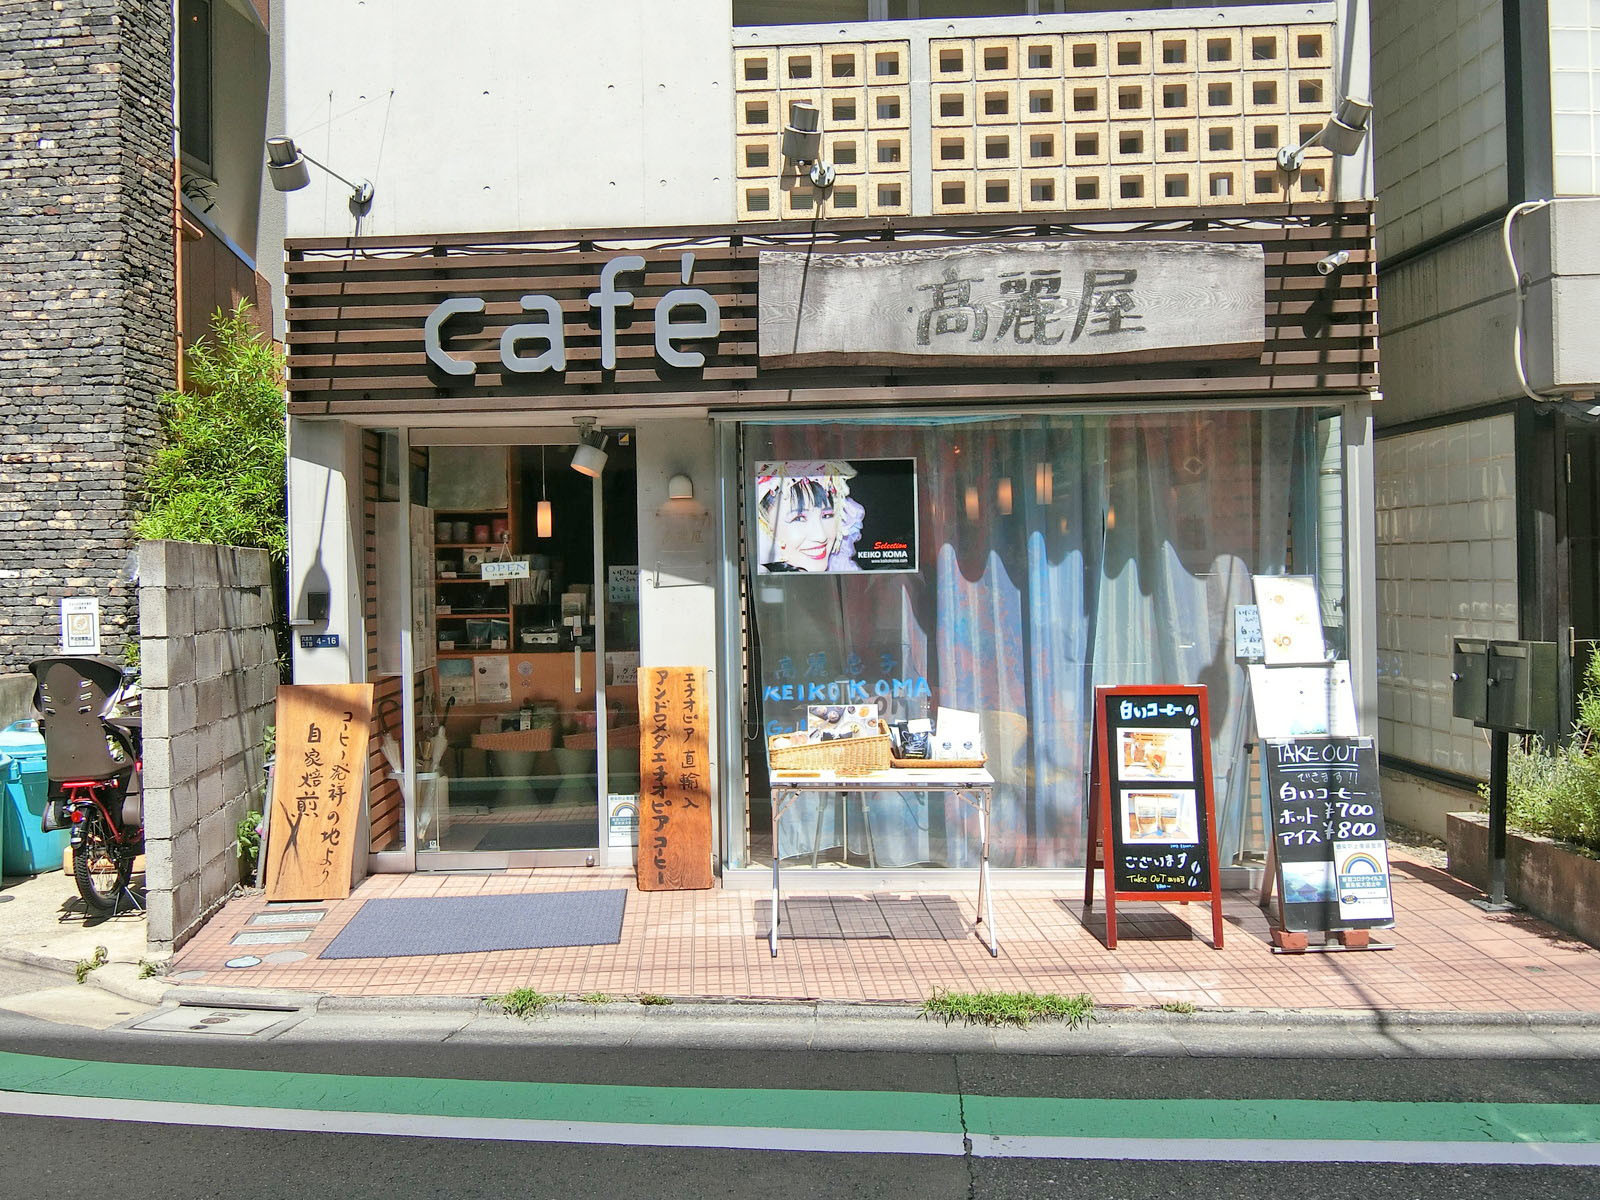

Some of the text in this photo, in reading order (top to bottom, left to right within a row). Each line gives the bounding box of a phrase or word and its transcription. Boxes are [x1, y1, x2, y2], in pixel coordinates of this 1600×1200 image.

[424, 252, 721, 376] café
[874, 541, 908, 549] Selection
[857, 551, 881, 559] KEIKO
[485, 563, 527, 572] OPEN
[316, 636, 337, 645] 4-16
[763, 677, 932, 702] KEIKO KOMA
[1120, 699, 1183, 720] 白いコーヒー
[1270, 743, 1360, 763] TAKE OUT
[291, 722, 324, 818] 自家焙煎
[1279, 782, 1367, 802] 白いコーヒー
[1279, 806, 1320, 825] ホット
[1278, 829, 1322, 846] アイス
[1125, 852, 1188, 869] ございます
[1126, 873, 1148, 884] Take
